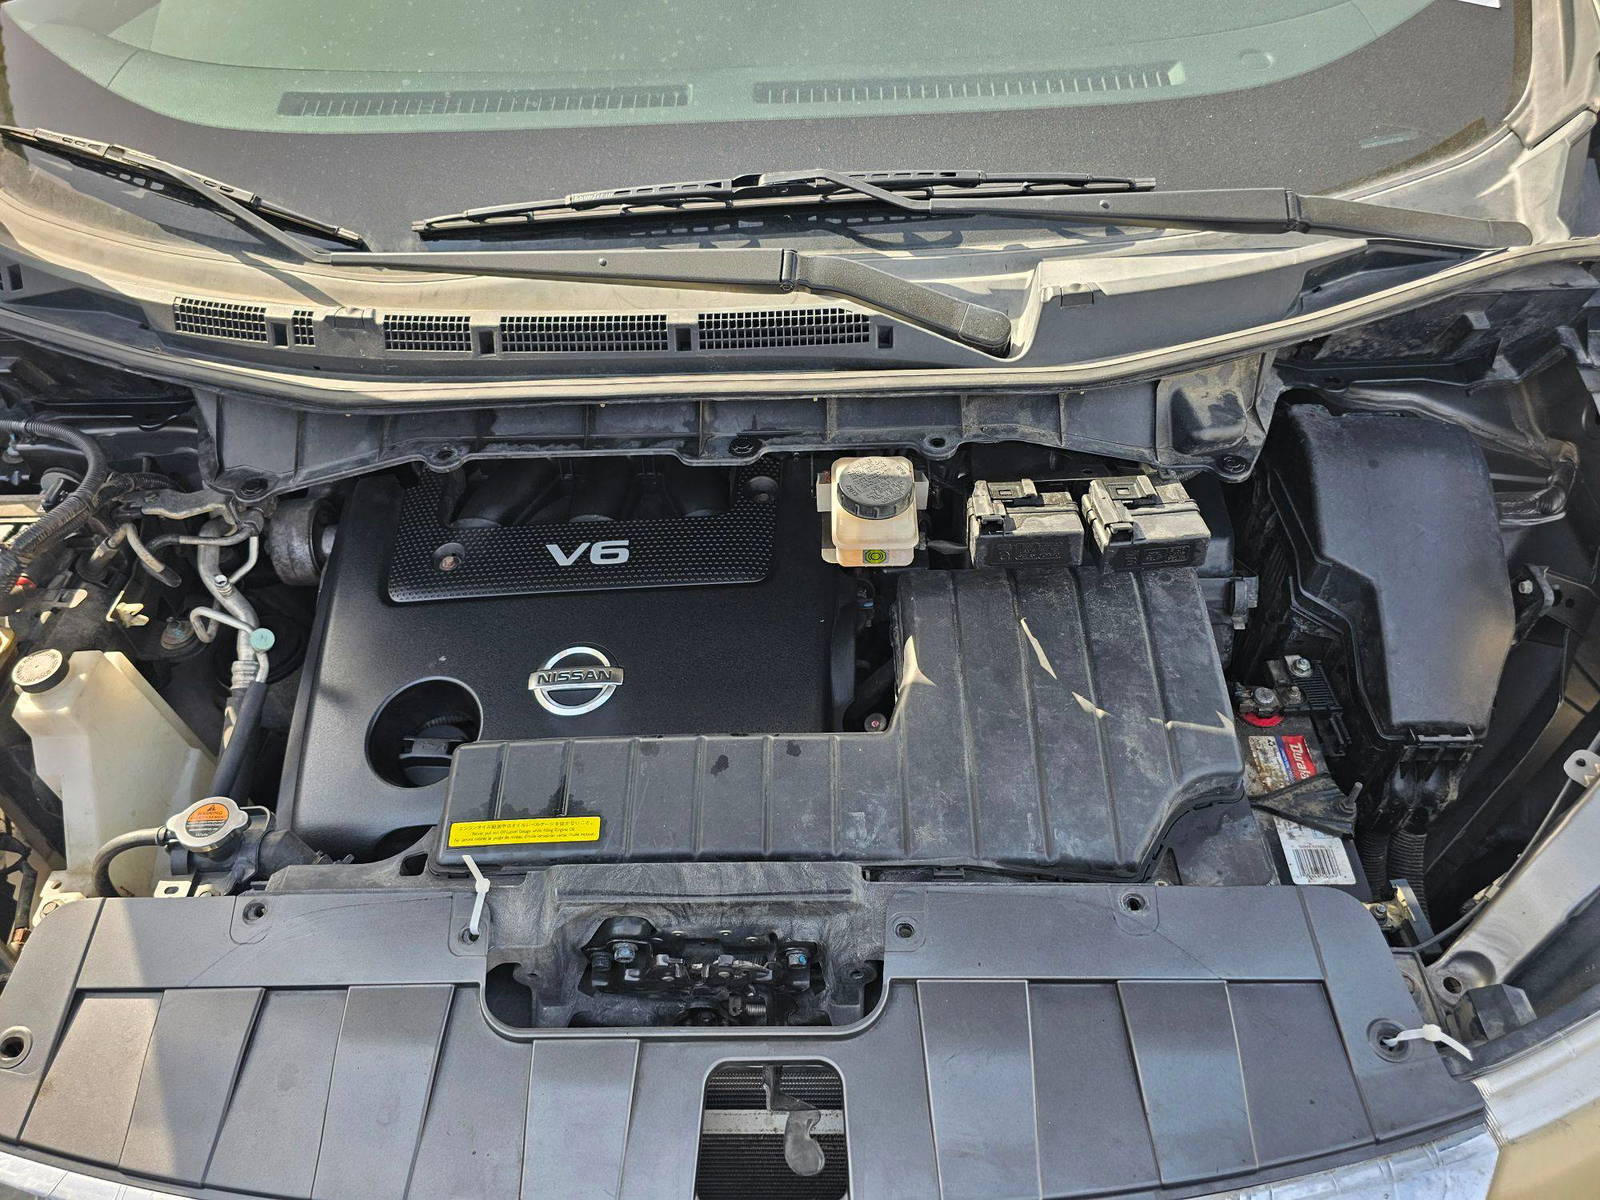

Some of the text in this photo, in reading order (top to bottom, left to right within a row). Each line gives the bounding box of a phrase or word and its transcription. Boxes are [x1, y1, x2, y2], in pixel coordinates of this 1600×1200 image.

[545, 539, 630, 567] V6
[537, 669, 613, 685] NISSAN
[1289, 742, 1311, 779] Durala
